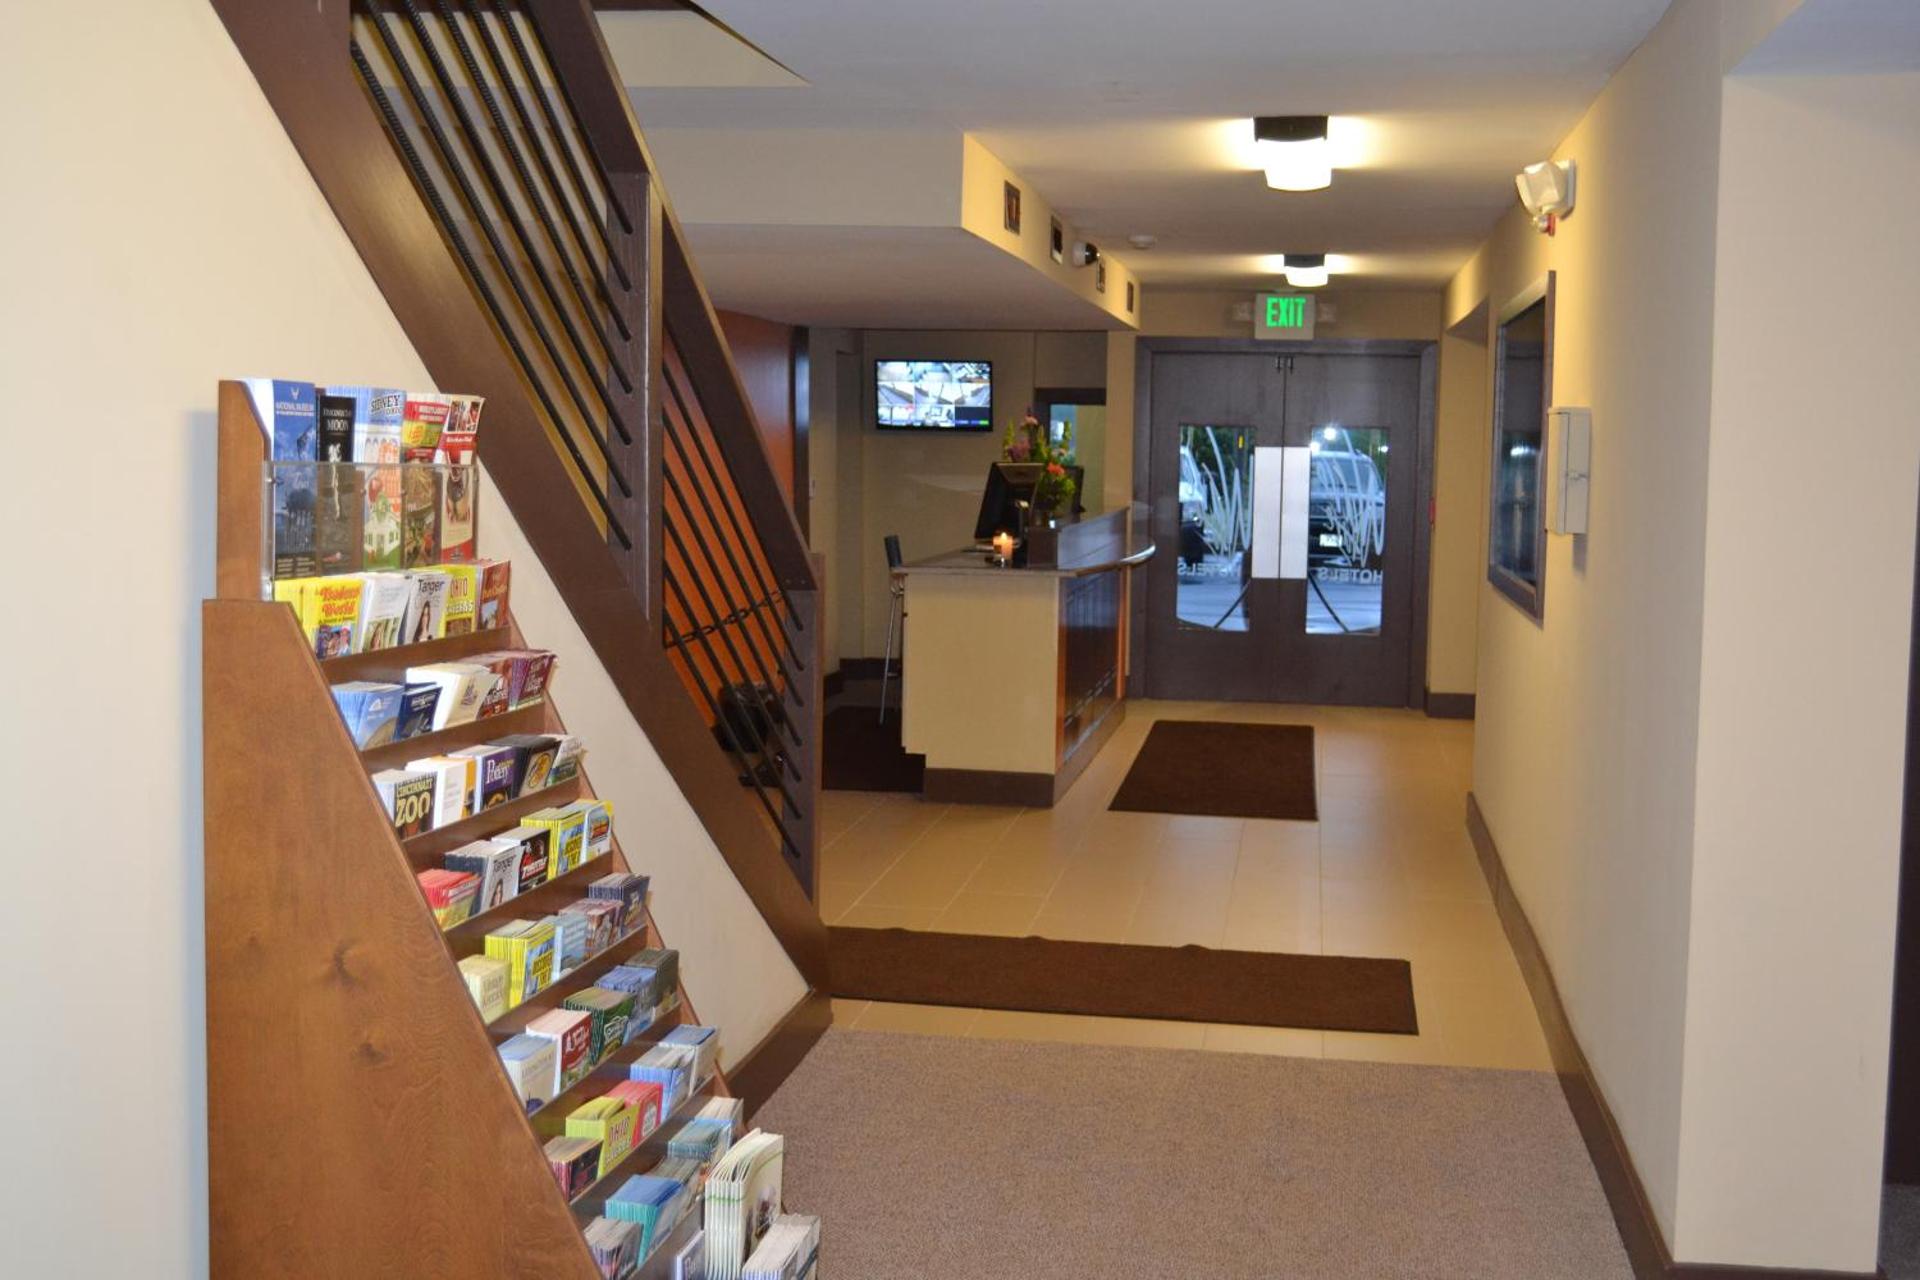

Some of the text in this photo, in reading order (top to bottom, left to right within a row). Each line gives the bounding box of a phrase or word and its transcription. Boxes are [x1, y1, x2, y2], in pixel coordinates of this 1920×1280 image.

[1267, 296, 1306, 328] EXIT
[371, 394, 400, 411] SIDNEY
[395, 791, 431, 827] ZOO
